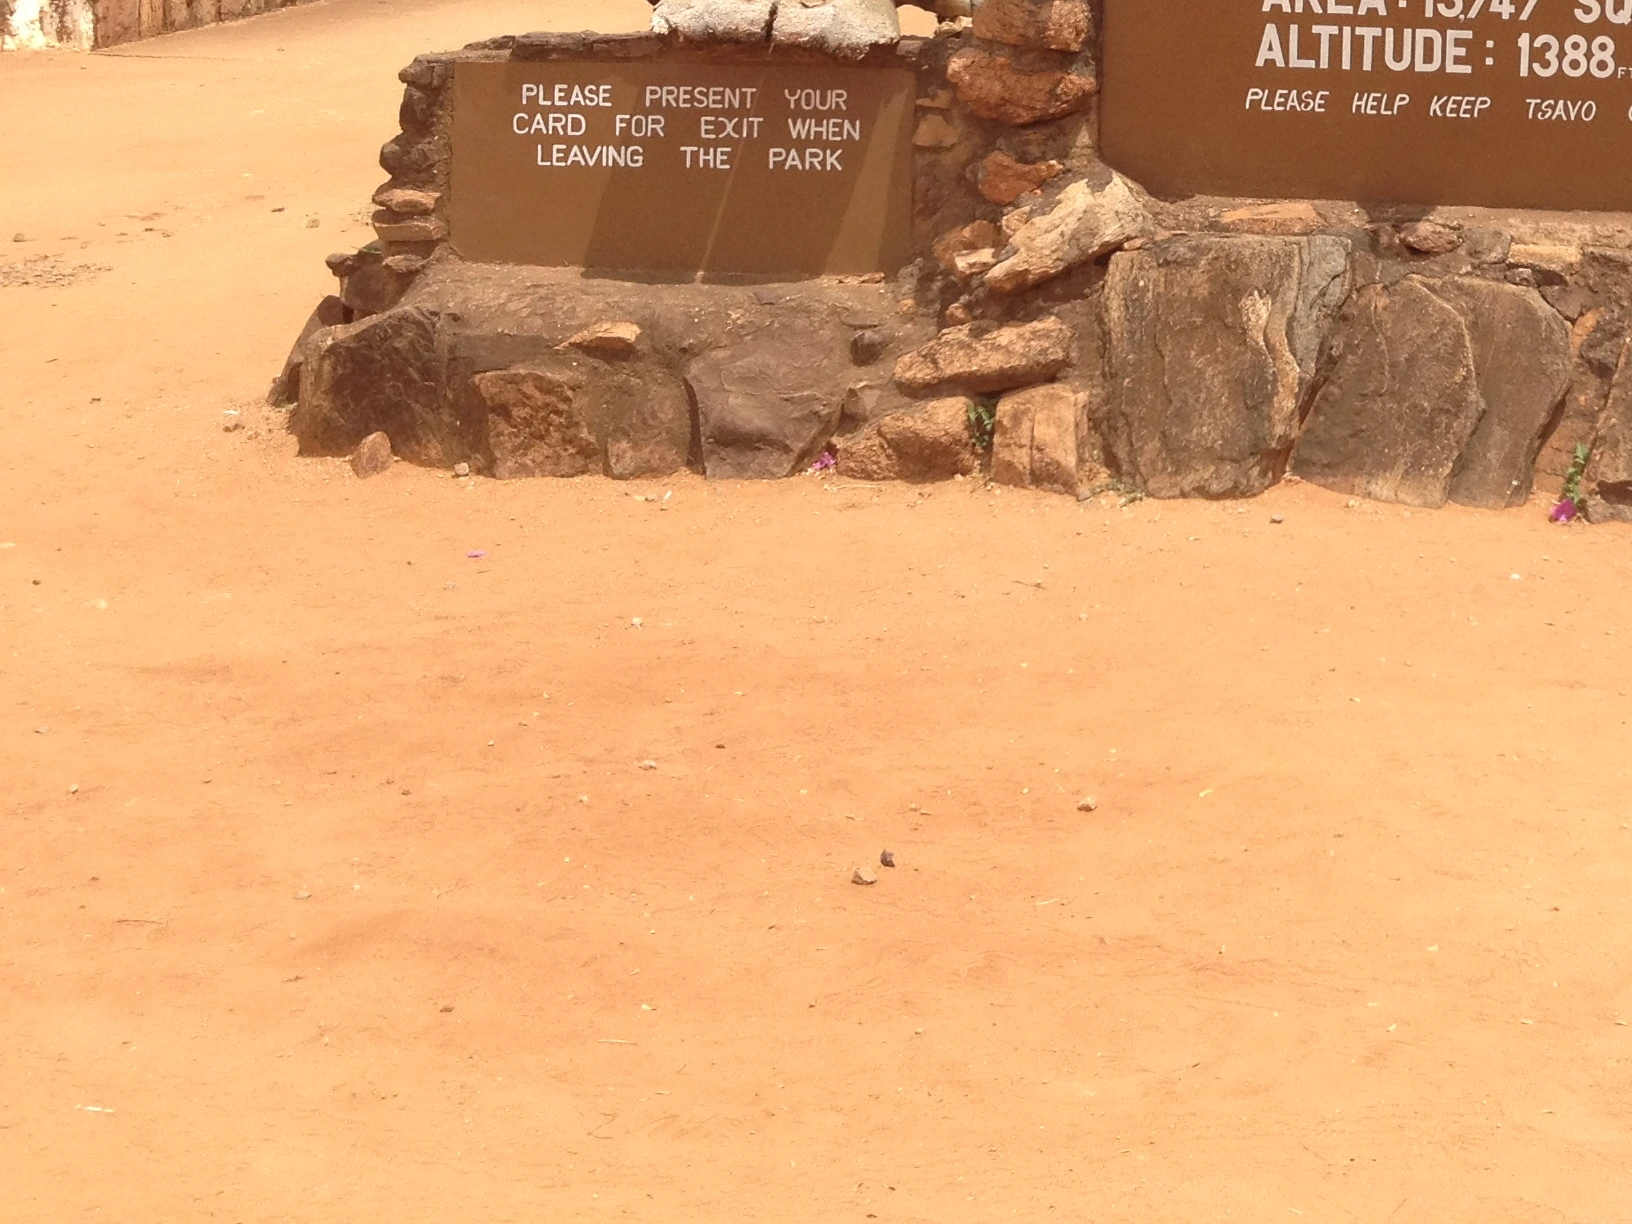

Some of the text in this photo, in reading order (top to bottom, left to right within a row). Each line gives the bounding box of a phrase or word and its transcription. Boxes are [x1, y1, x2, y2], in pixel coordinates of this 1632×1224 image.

[1255, 24, 1495, 74] ALTITUDE:
[523, 84, 847, 110] PLEASE PRESENT YOUR
[1246, 88, 1329, 112] PLEASE
[1353, 93, 1409, 114] HELP
[1430, 96, 1490, 117] KEEP
[1526, 99, 1596, 121] TSAVO
[513, 113, 859, 140] CARD FOR EXIT WHEN
[538, 145, 842, 170] LEAVING THE PARK
